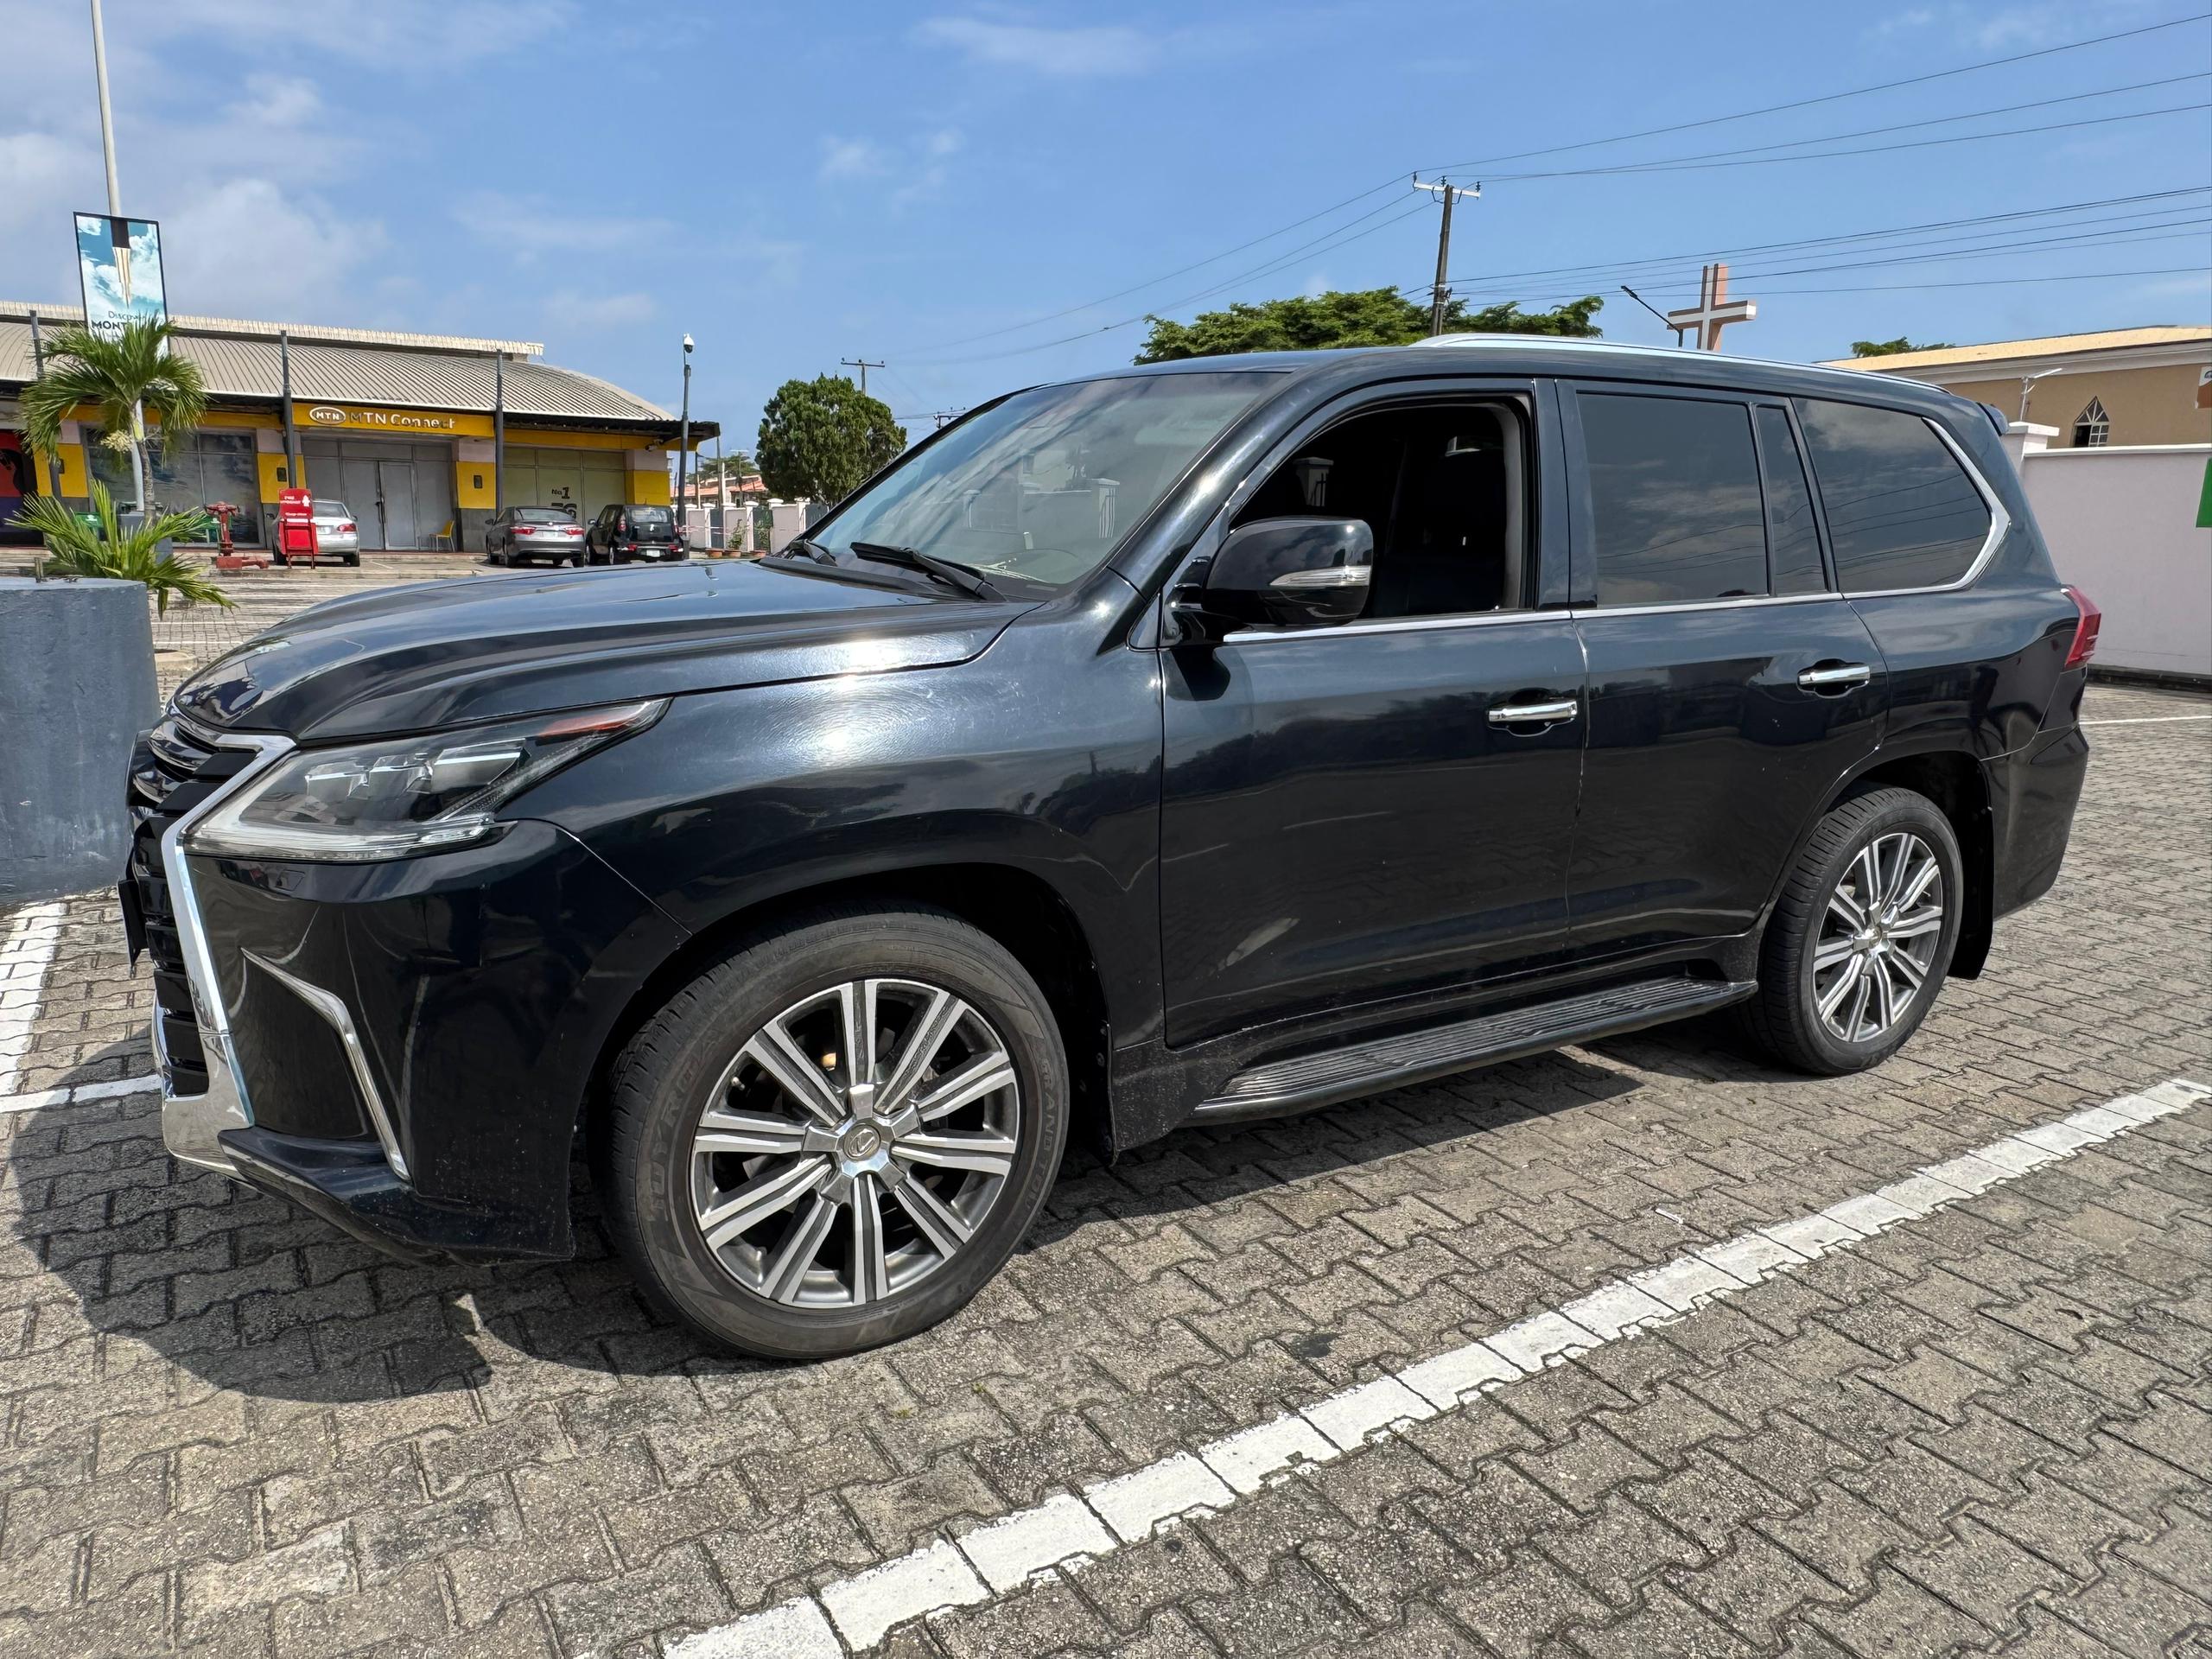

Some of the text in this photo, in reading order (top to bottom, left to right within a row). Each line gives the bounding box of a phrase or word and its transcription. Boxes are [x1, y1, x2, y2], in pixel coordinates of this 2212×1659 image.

[92, 320, 127, 330] MONT
[315, 411, 340, 421] MTN
[350, 412, 455, 429] MTN Connect
